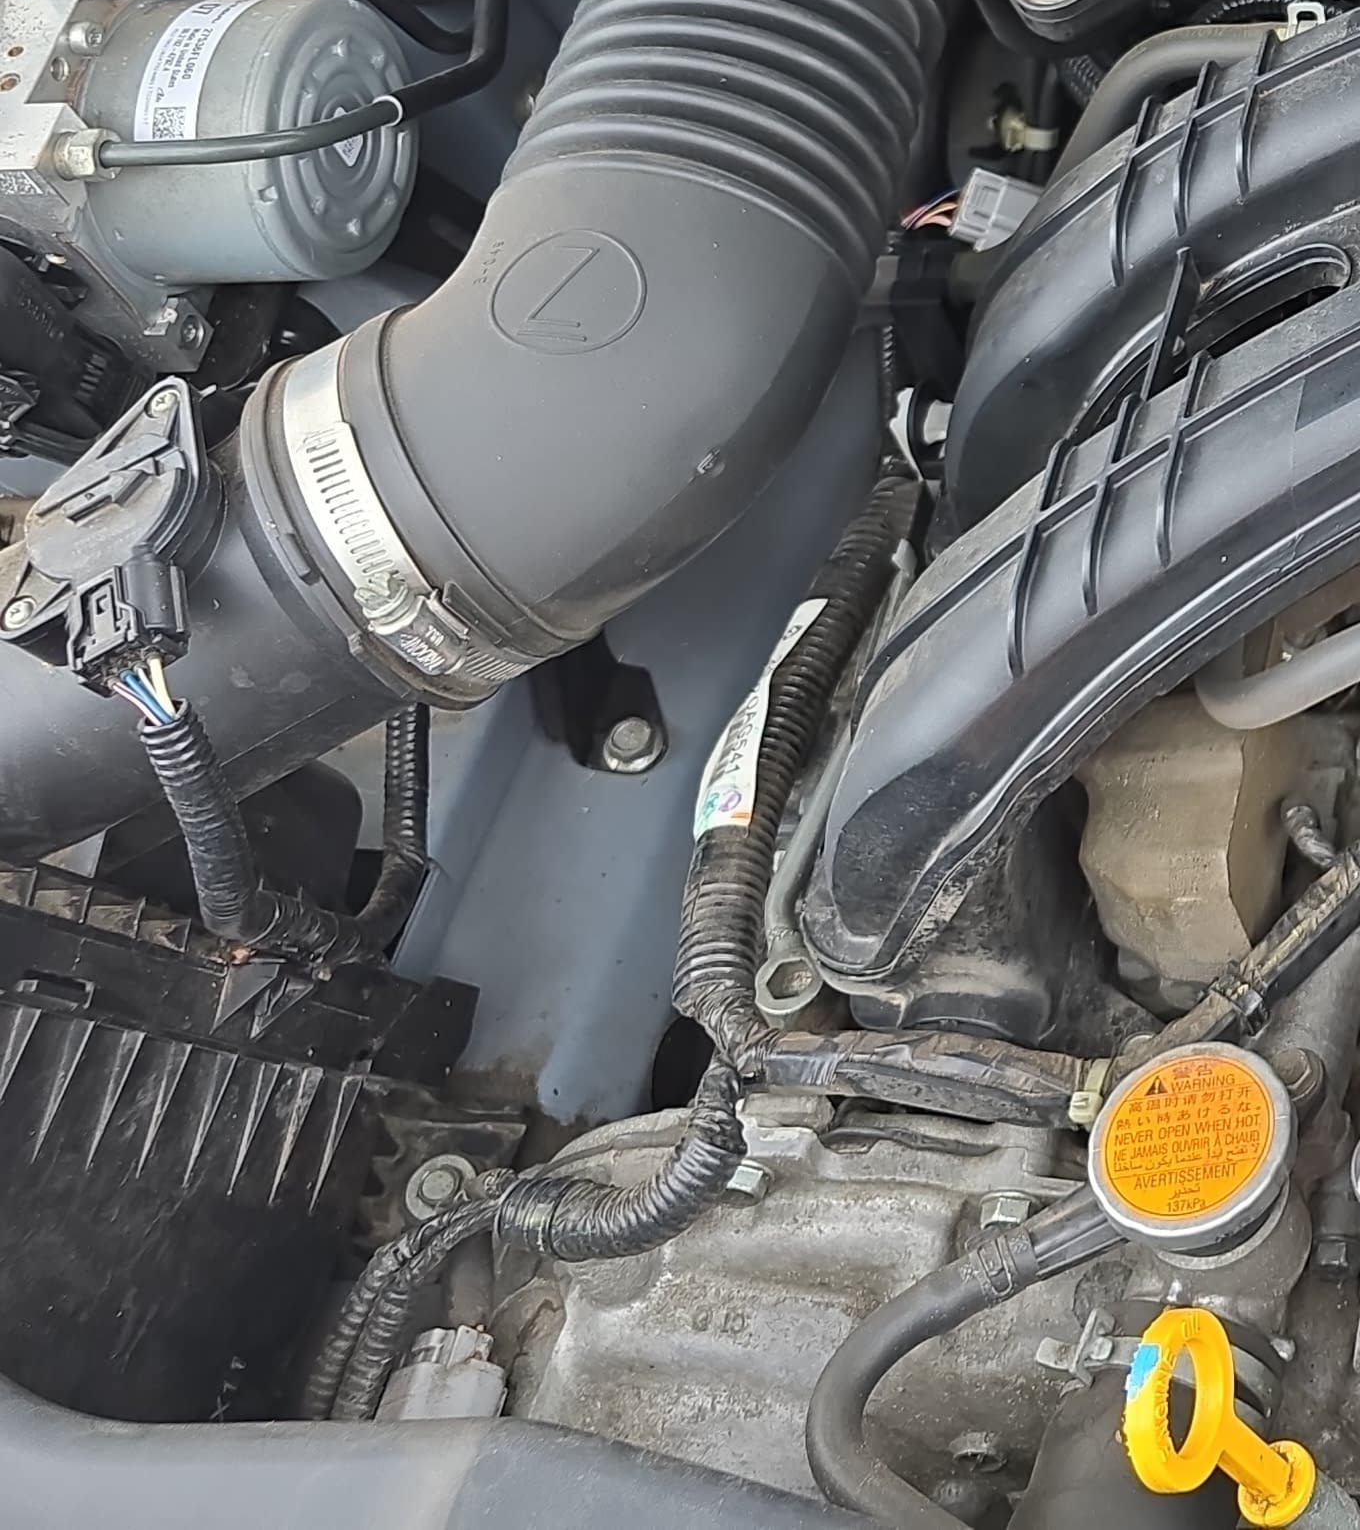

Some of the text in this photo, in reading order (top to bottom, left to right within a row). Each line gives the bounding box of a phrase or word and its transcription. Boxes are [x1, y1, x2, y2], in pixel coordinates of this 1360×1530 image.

[191, 3, 221, 16] 07
[1172, 1063, 1214, 1080] 警告
[1171, 1074, 1236, 1093] WARNING
[1115, 1129, 1153, 1147] NEVER
[1158, 1124, 1191, 1140] OPEN
[1194, 1118, 1231, 1135] WHEN
[1113, 1147, 1129, 1162] NE
[1130, 1143, 1168, 1161] JAMAIS
[1172, 1136, 1210, 1155] OUVRIR
[1225, 1130, 1260, 1147] CHAUD
[1134, 1163, 1239, 1190] AVERTISSEMENT
[1166, 1198, 1207, 1213] 137kPa
